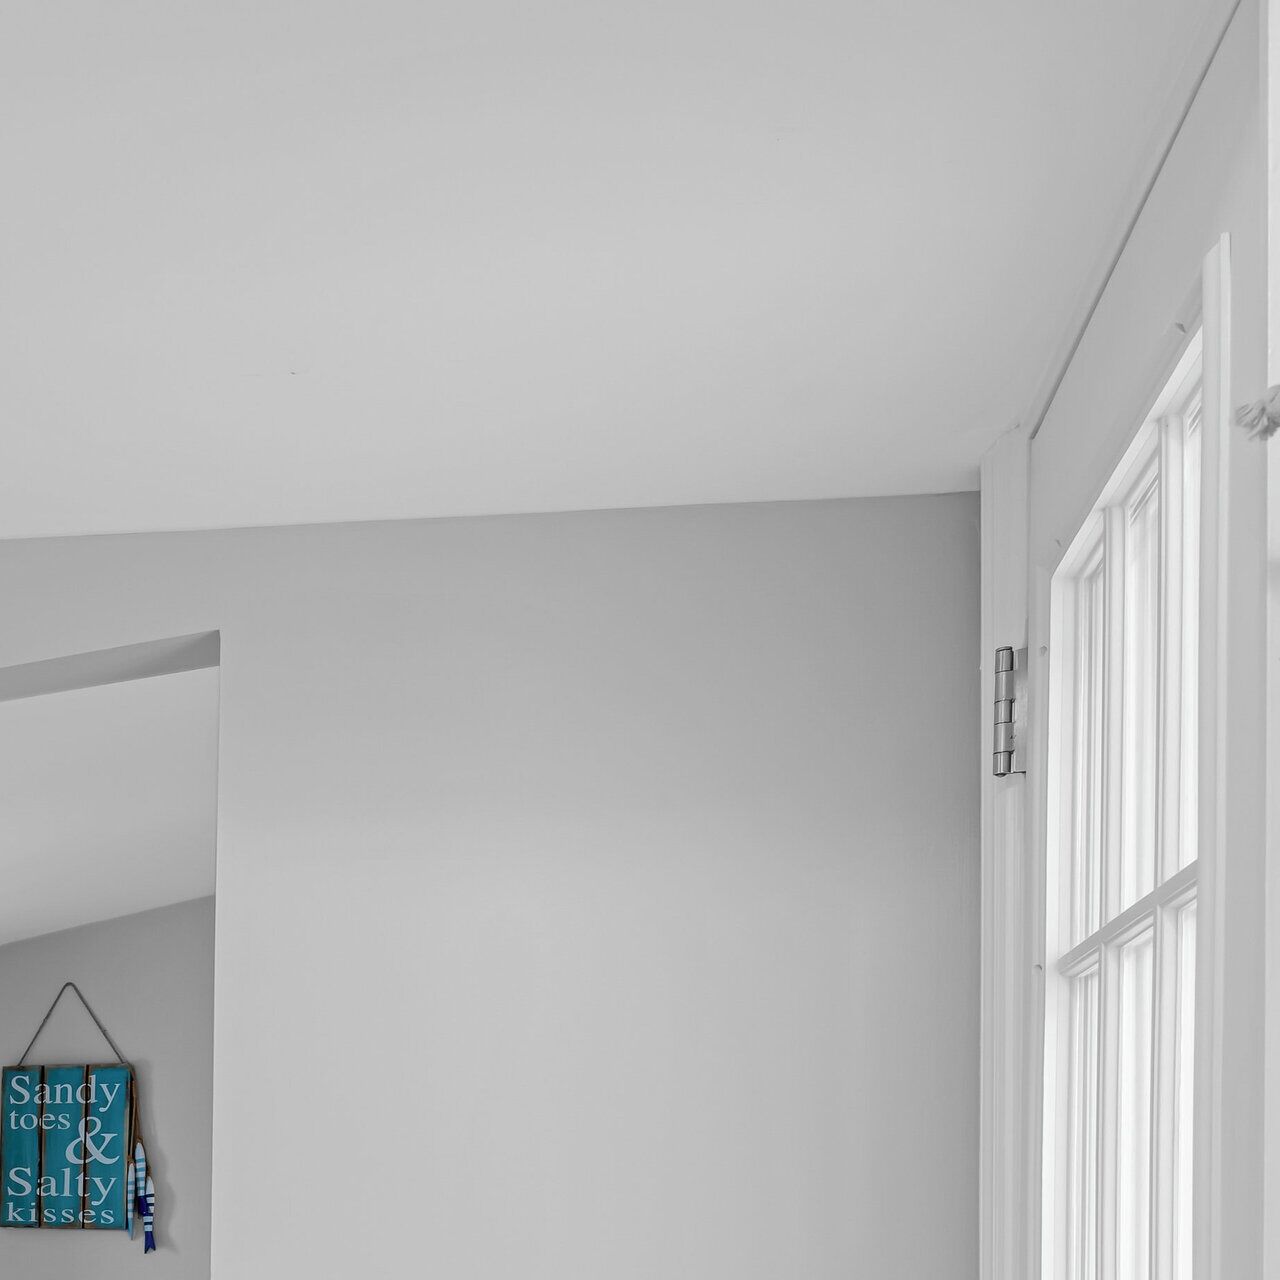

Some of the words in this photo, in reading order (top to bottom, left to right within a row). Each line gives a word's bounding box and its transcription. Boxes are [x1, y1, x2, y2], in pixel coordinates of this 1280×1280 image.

[9, 1074, 121, 1113] Sandy
[9, 1110, 71, 1130] toes
[65, 1116, 120, 1165] &
[7, 1167, 118, 1206] Salty
[6, 1202, 115, 1225] kisses
